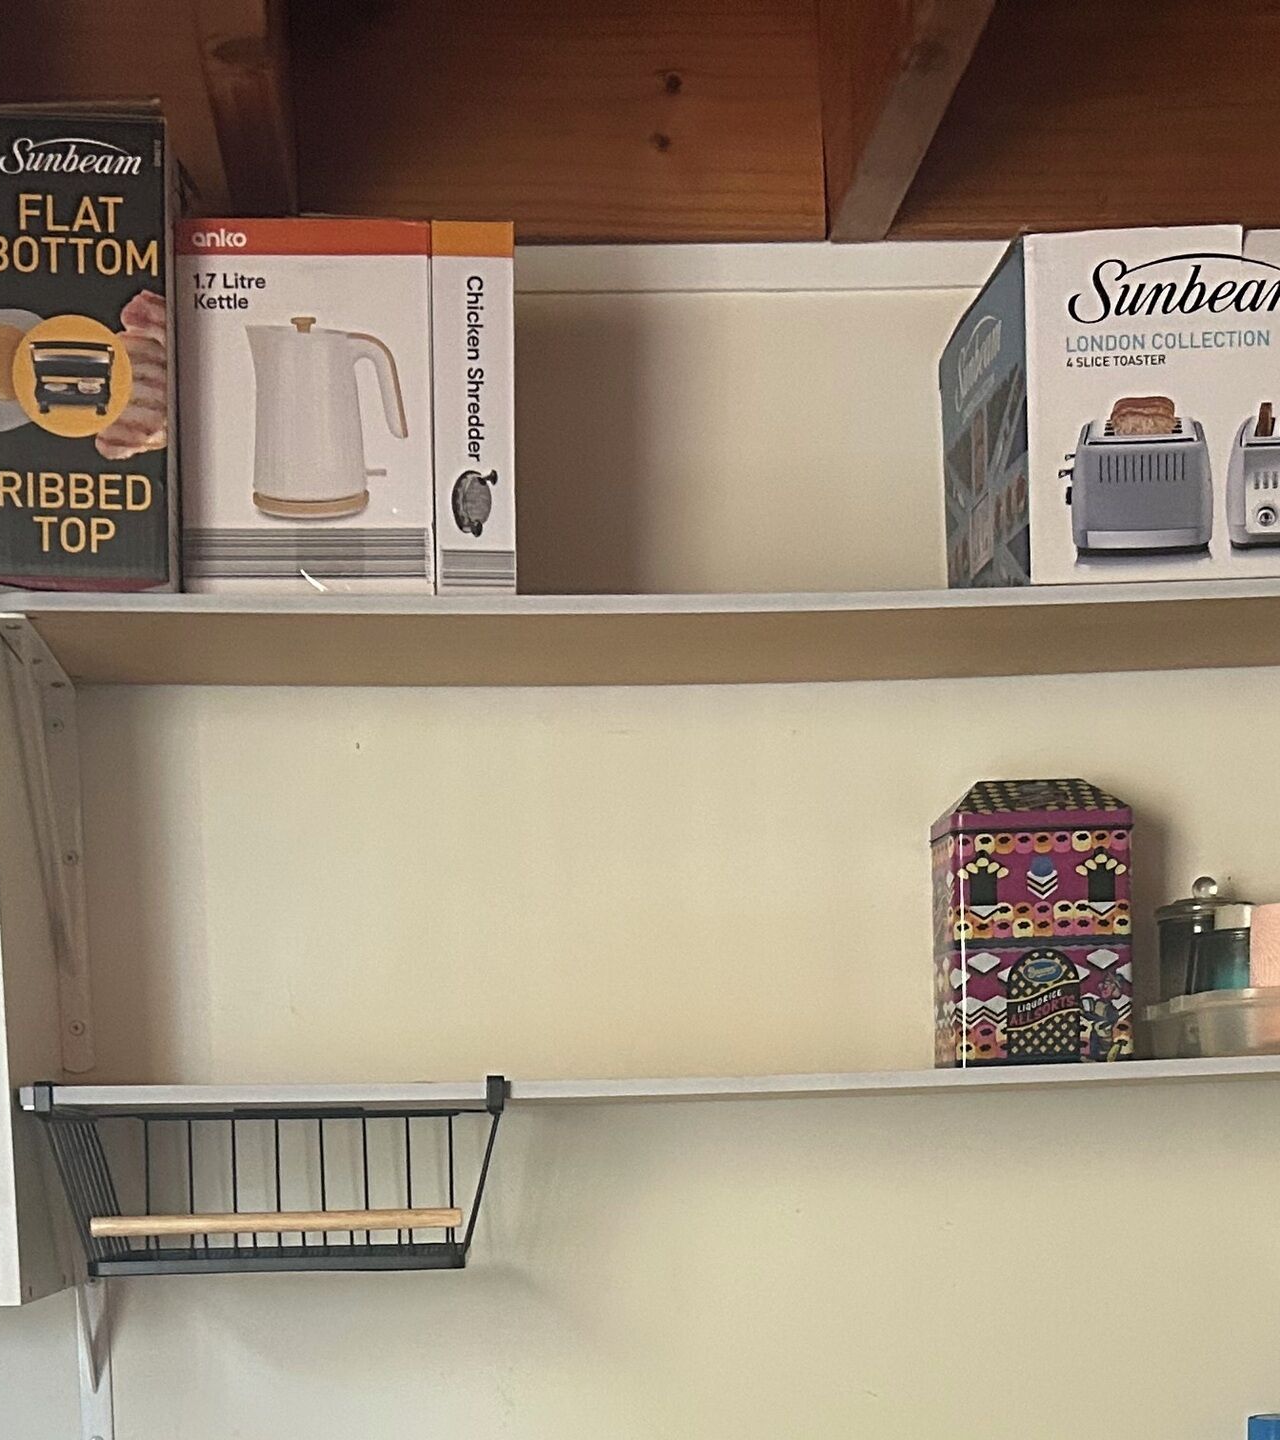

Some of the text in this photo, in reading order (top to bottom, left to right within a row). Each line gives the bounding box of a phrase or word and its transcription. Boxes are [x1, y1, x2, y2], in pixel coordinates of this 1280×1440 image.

[18, 193, 124, 234] FLAT
[192, 227, 248, 248] anko
[192, 272, 266, 289] 1.7 Litre
[193, 293, 249, 310] Kettle
[1066, 329, 1271, 353] LONDON COLLECTION
[466, 275, 484, 462] Chicken Shredder
[1066, 354, 1166, 368] 4 SLICE TOASTER
[33, 515, 116, 554] TOP
[1008, 995, 1076, 1026] ALLSORTS
[1017, 989, 1062, 1014] LIQUORICE
